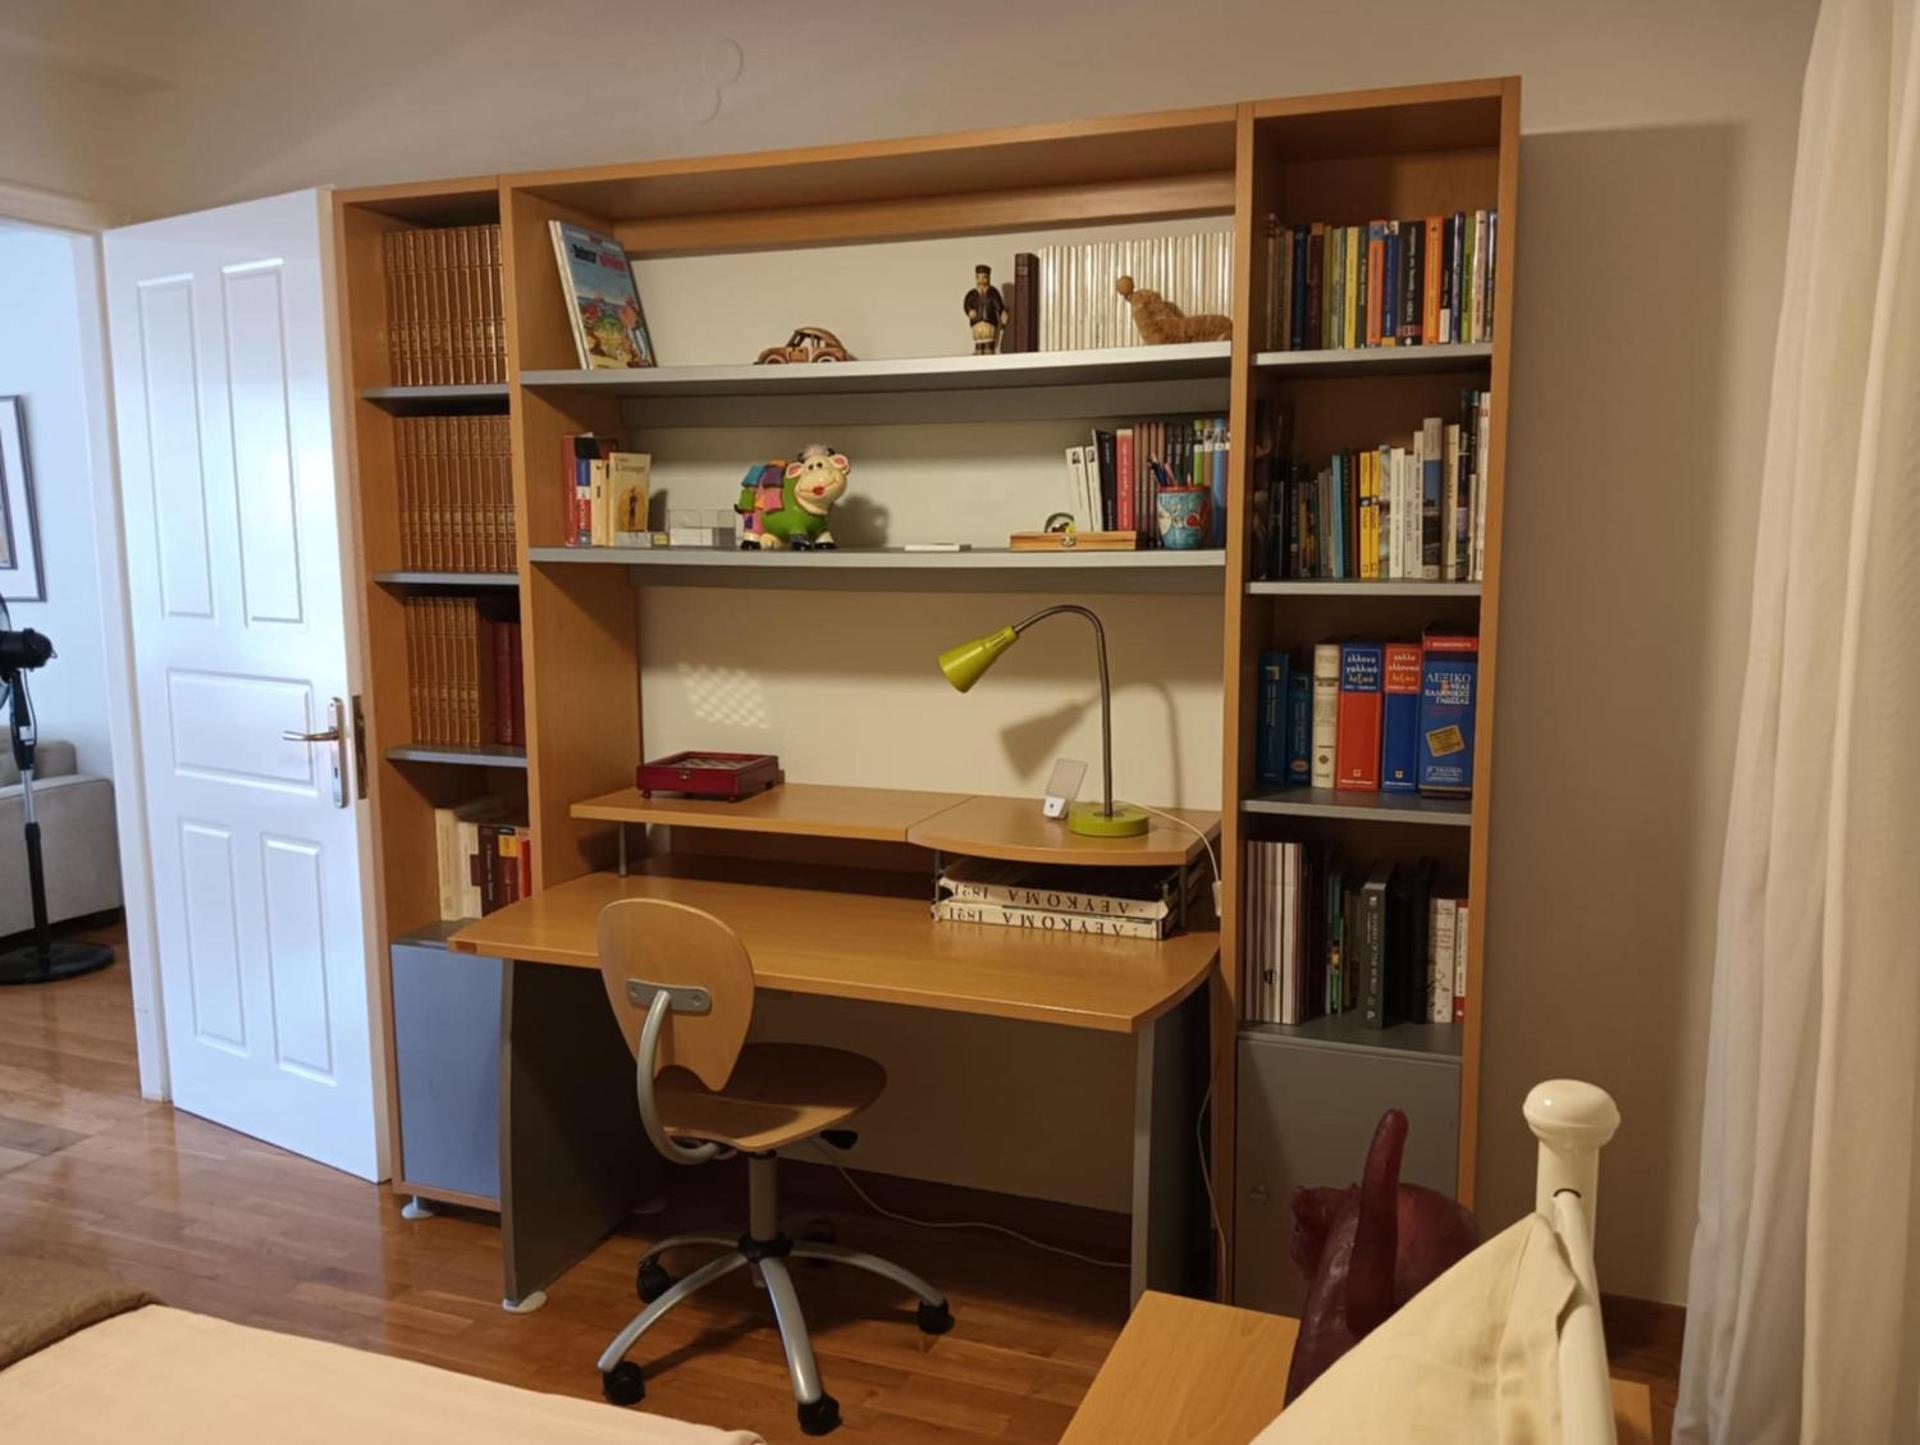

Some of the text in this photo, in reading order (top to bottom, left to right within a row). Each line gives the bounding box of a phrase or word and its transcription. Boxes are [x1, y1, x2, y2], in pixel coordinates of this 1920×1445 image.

[1426, 672, 1472, 683] ΛΕΞΙΚΟ
[954, 884, 989, 899] 1821
[950, 908, 983, 923] 1821
